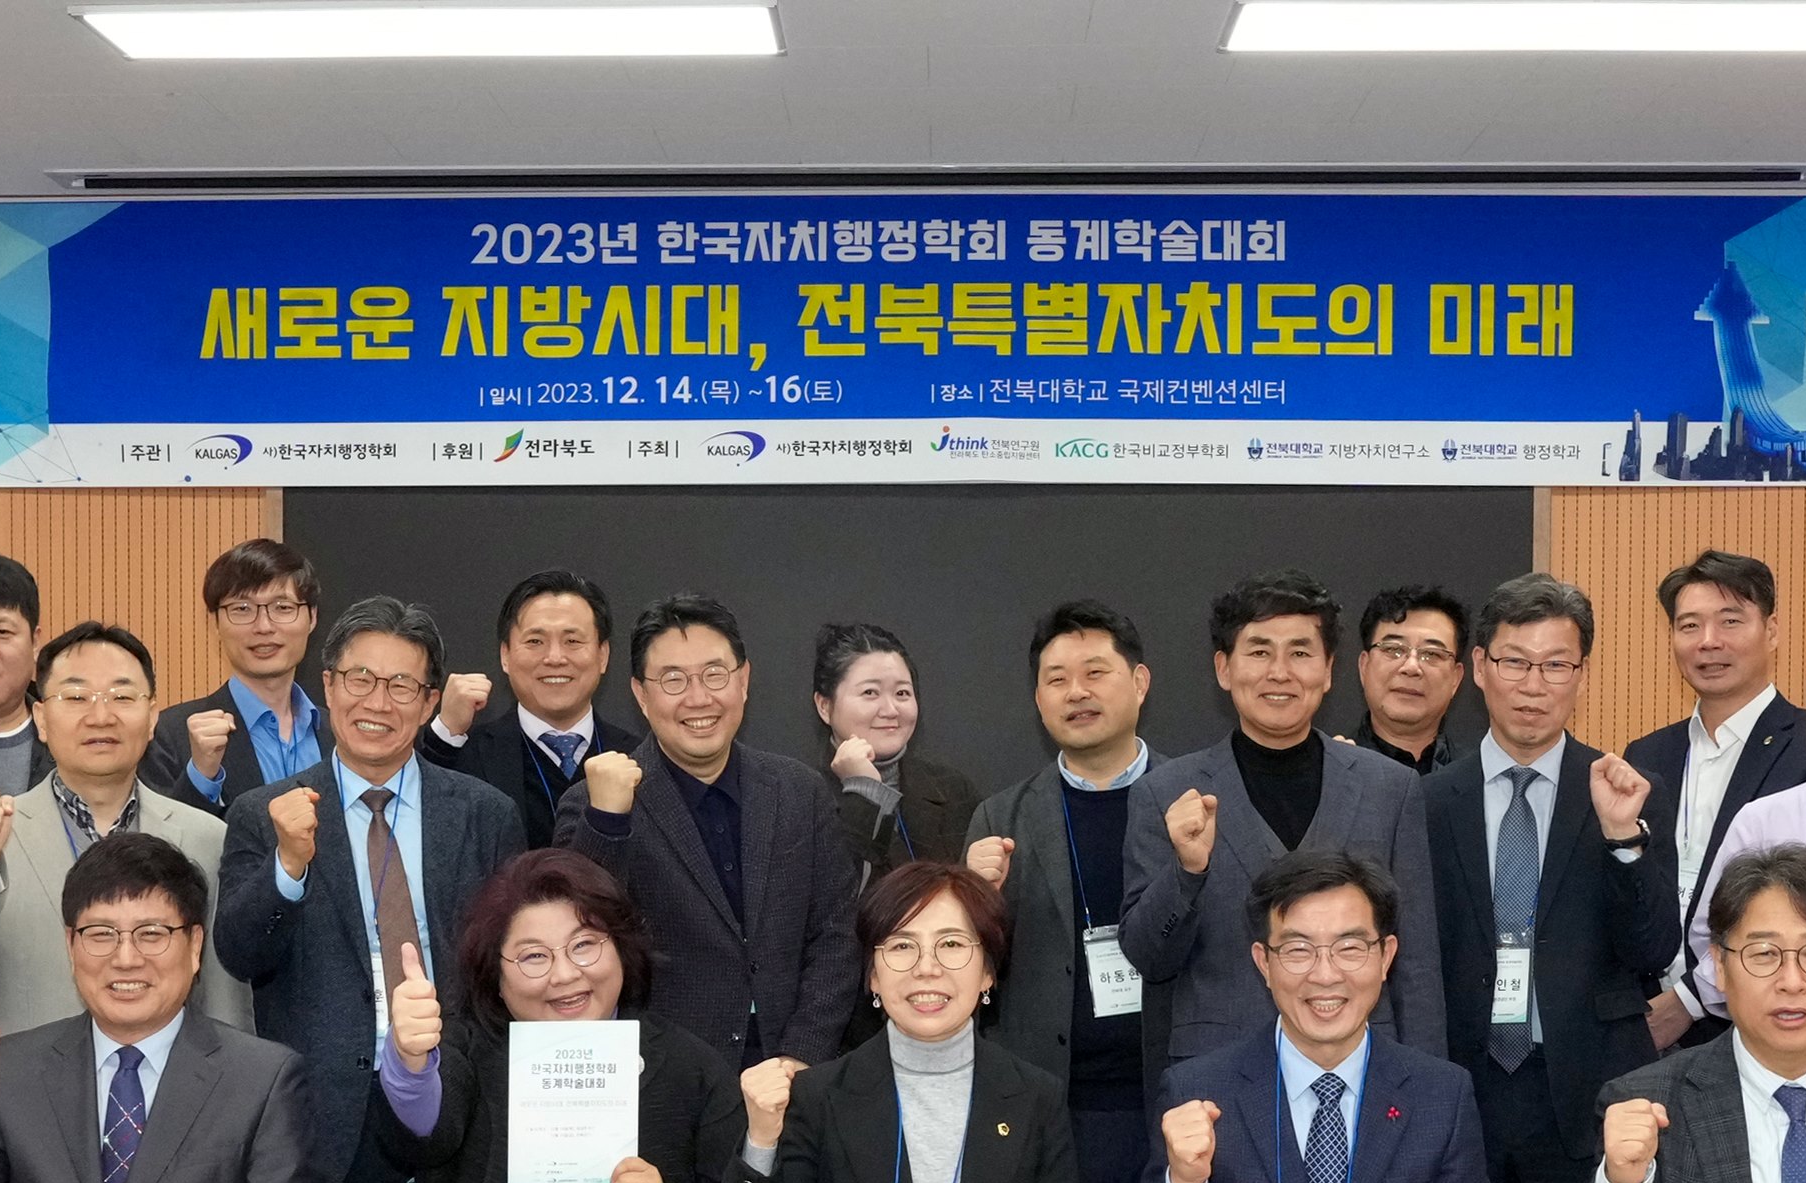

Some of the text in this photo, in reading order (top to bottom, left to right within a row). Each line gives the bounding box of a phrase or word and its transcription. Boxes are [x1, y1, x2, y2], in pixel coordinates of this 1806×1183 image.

[470, 218, 1286, 265] 2023년 한국자치행정학회 동계학술대회
[200, 282, 1574, 371] 새로운 지방시대, 전북특별자치도의 미래
[989, 378, 1110, 404] 전북대학교
[1117, 378, 1286, 405] 국제컨벤션센터
[195, 447, 238, 460] KALGAS
[524, 438, 596, 458] 전라북도
[707, 445, 751, 457] KALGAS
[990, 439, 1040, 452] 전북연구원
[1055, 438, 1109, 458] KACG
[1112, 442, 1229, 460] 한국비교정부학회
[1265, 442, 1431, 460] 전북대학교 지방자치연구소
[1459, 443, 1582, 461] 전북대학교 행정학과
[554, 1049, 593, 1061] 2023년
[530, 1063, 617, 1075] 한국자치행정학회
[541, 1078, 606, 1090] 동계학술대회
